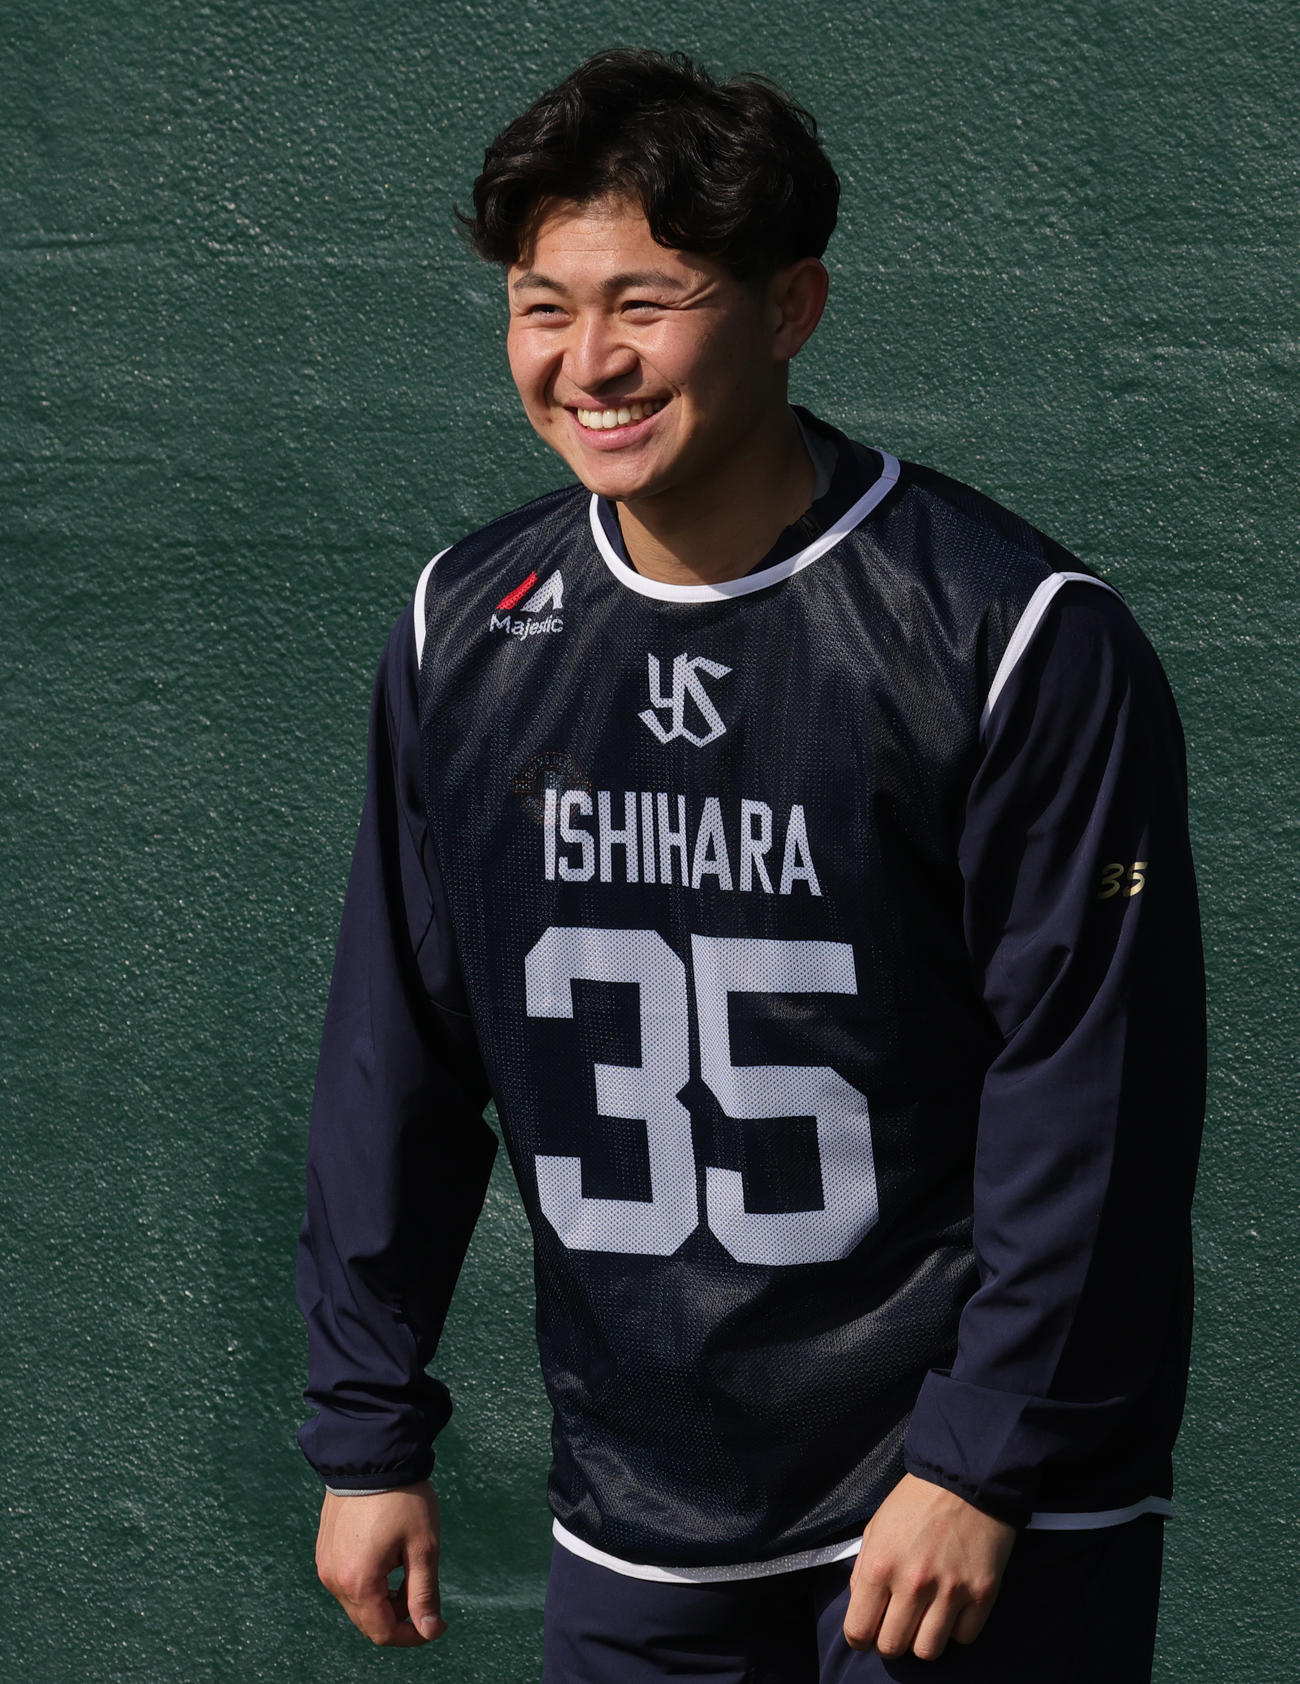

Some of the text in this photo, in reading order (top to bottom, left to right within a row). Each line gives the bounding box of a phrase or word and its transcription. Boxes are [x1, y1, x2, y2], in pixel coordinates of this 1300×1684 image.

[489, 613, 564, 641] Majestic
[543, 787, 823, 897] ISHIHARA
[1096, 861, 1149, 900] 35
[525, 926, 880, 1266] 35
